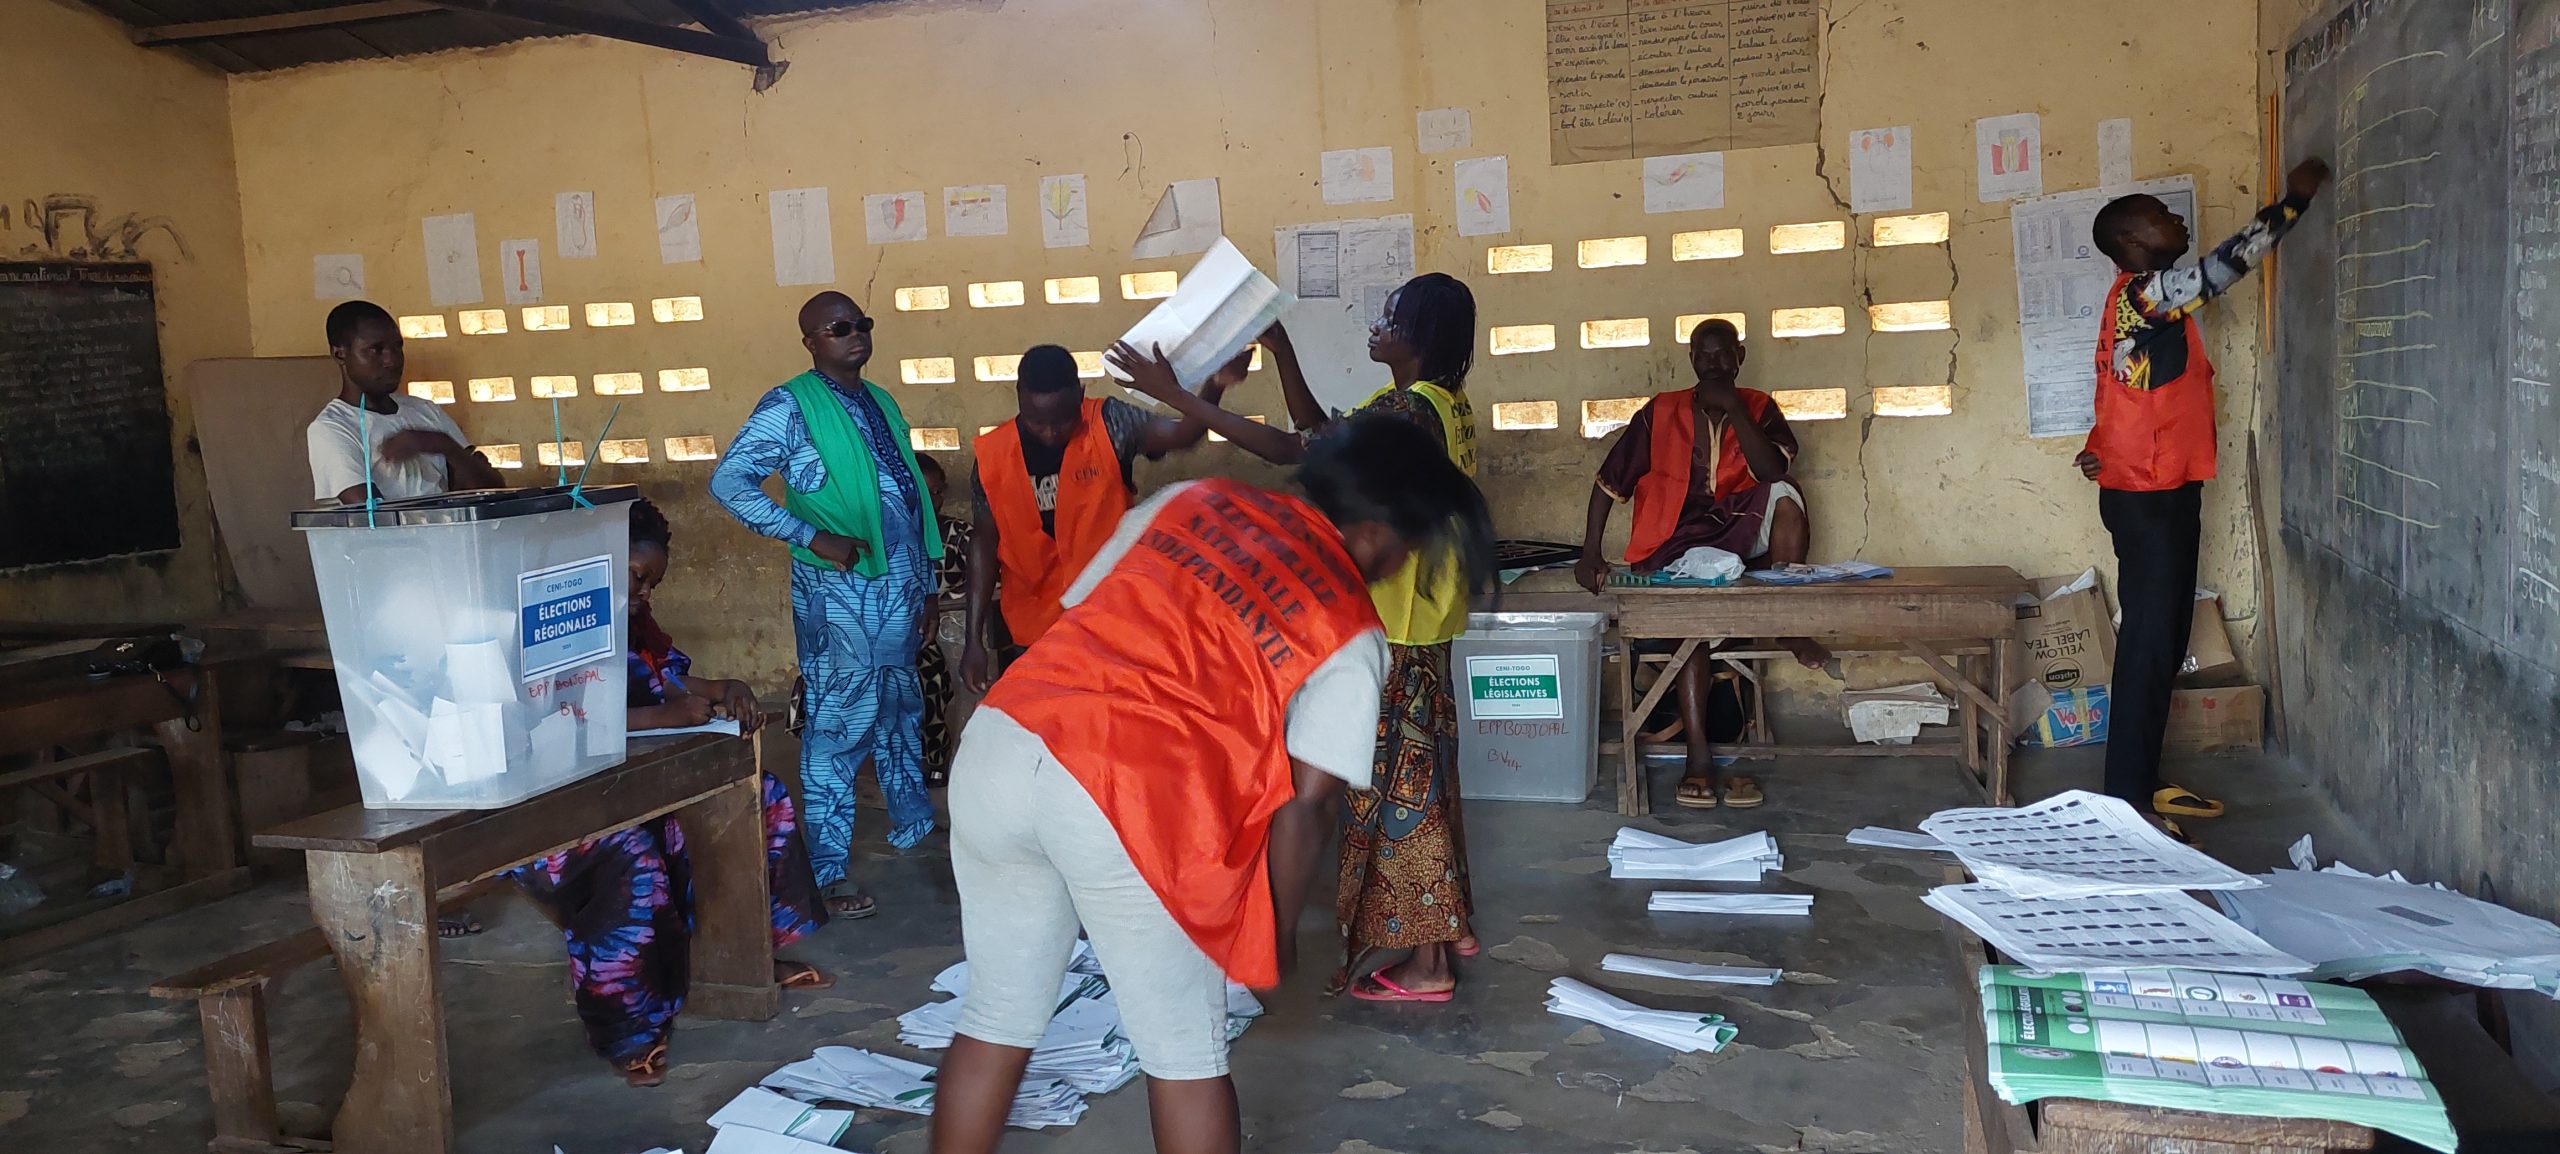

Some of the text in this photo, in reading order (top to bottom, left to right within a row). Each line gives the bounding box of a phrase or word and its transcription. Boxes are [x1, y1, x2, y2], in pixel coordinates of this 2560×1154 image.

[546, 577, 582, 593] CENI-TOGO
[538, 595, 592, 621] ÉLECTIONS
[534, 613, 597, 643] RÉGIONALES
[2023, 637, 2049, 650] TEA
[2053, 628, 2091, 645] LABEL
[2035, 642, 2086, 661] YELLOW
[1489, 676, 1540, 687] ÉLECTIONS
[2048, 671, 2078, 681] Lipton
[1483, 687, 1548, 699] LÉGISLATIVES
